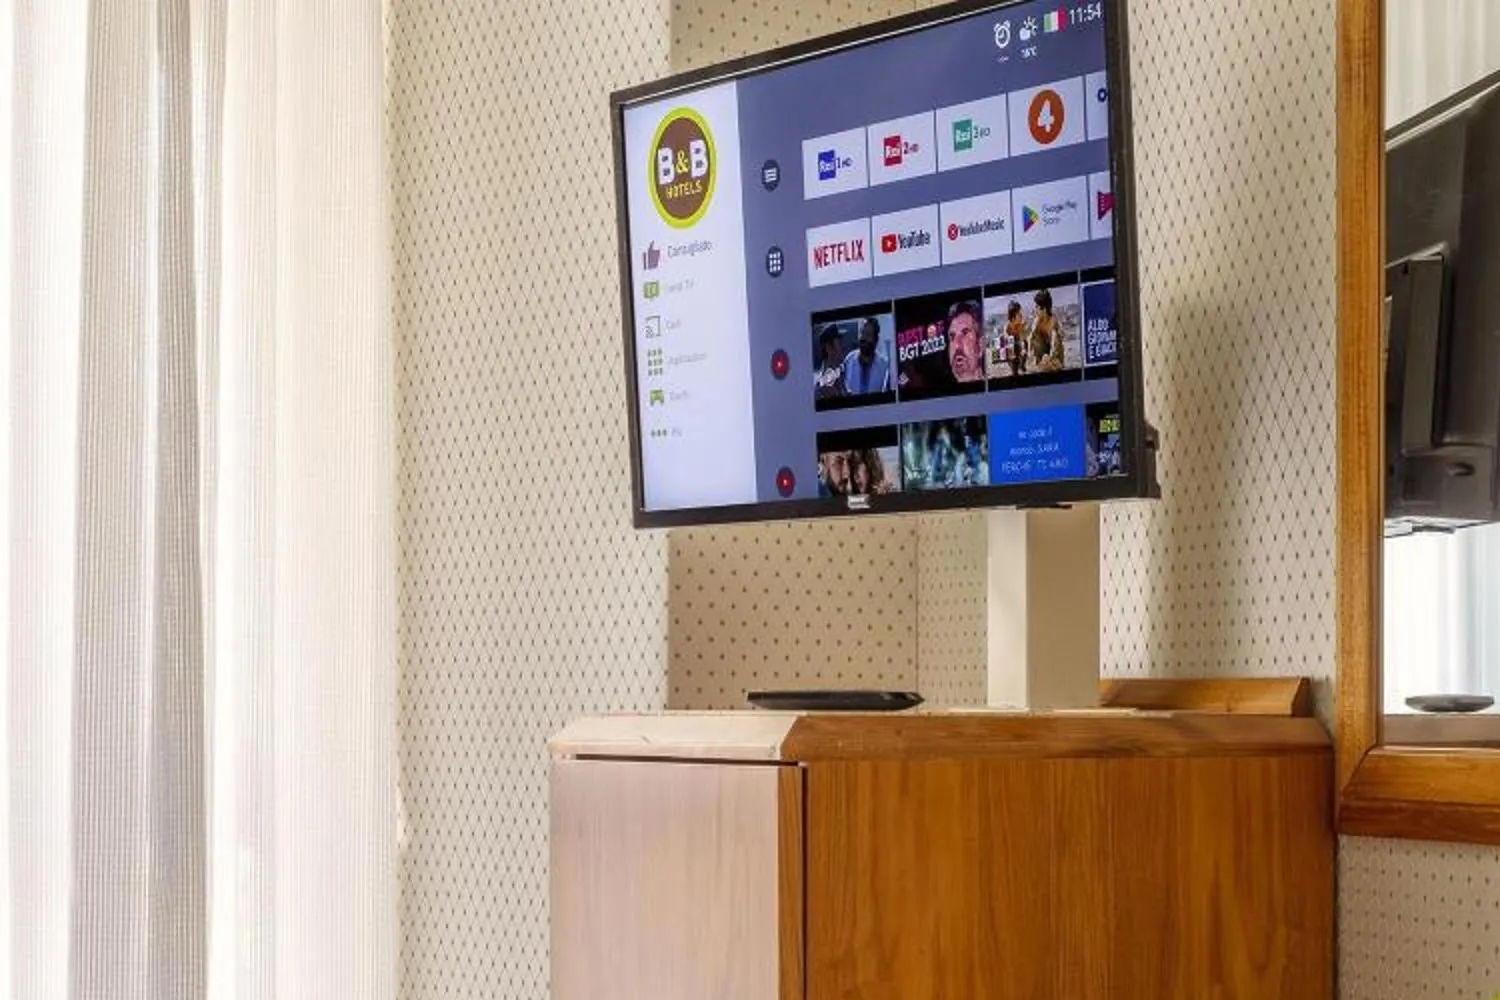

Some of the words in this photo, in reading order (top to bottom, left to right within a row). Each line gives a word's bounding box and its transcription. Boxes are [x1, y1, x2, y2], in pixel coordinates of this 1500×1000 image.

[1037, 99, 1055, 133] 4
[658, 140, 708, 185] B&B
[665, 179, 703, 200] HOTELS
[897, 228, 931, 249] YouTube
[813, 239, 865, 271] NETFLIX
